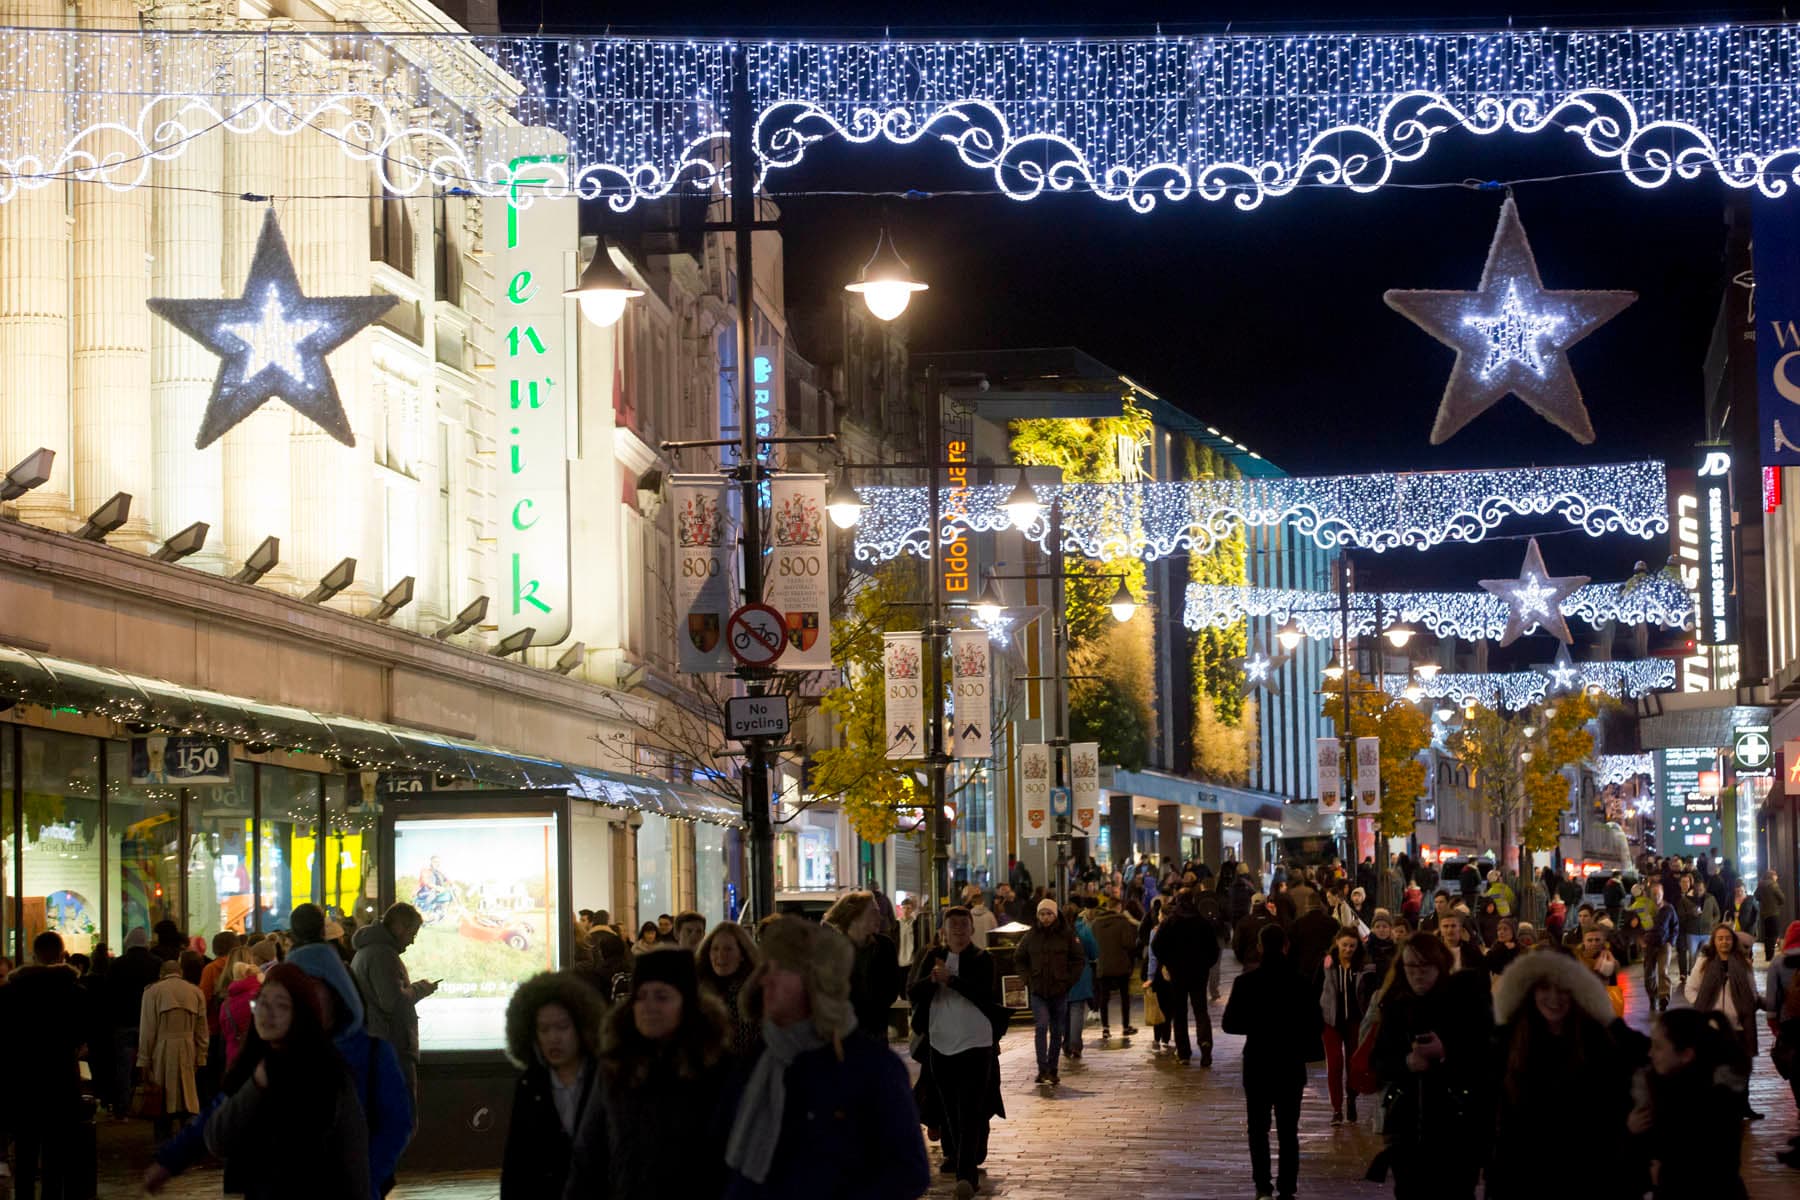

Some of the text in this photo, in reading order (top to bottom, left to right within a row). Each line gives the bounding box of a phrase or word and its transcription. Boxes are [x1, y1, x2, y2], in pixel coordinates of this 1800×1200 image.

[497, 154, 568, 615] Fenwick
[1698, 452, 1730, 476] JD
[682, 557, 721, 577] 800
[779, 556, 820, 576] 800
[890, 685, 918, 698] 800
[957, 684, 985, 697] 800
[750, 704, 767, 714] No
[735, 717, 784, 732] cycling
[177, 747, 220, 774] 150
